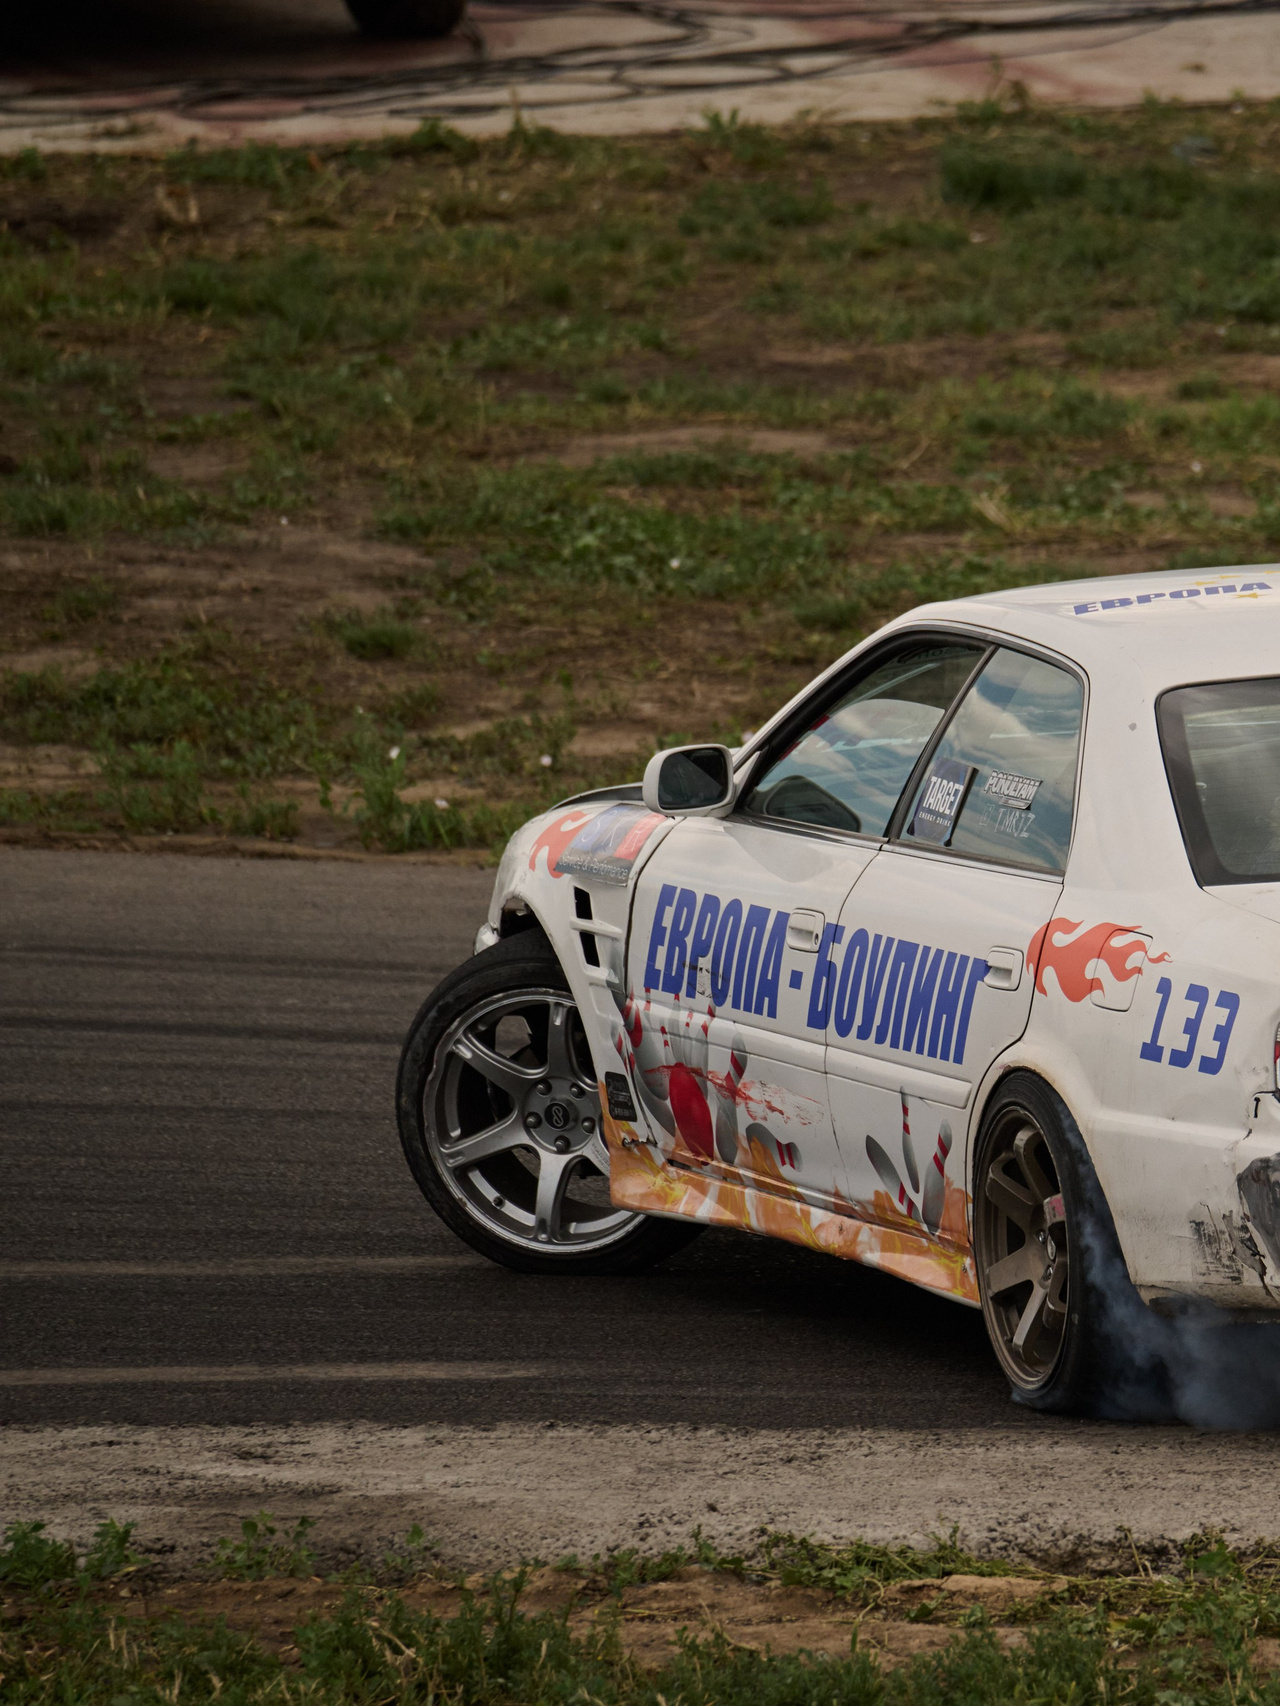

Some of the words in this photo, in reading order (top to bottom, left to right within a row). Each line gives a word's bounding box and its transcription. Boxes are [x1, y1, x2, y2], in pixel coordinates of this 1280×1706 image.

[1073, 580, 1272, 616] ЕВРОПА
[922, 776, 964, 816] TARGET
[918, 811, 936, 822] ENERGY
[936, 816, 952, 827] DRINK
[558, 851, 583, 870] Service
[643, 884, 791, 1019] ЕВРОПА
[806, 922, 991, 1065] БОУЛИНГ
[1139, 976, 1240, 1076] 133
